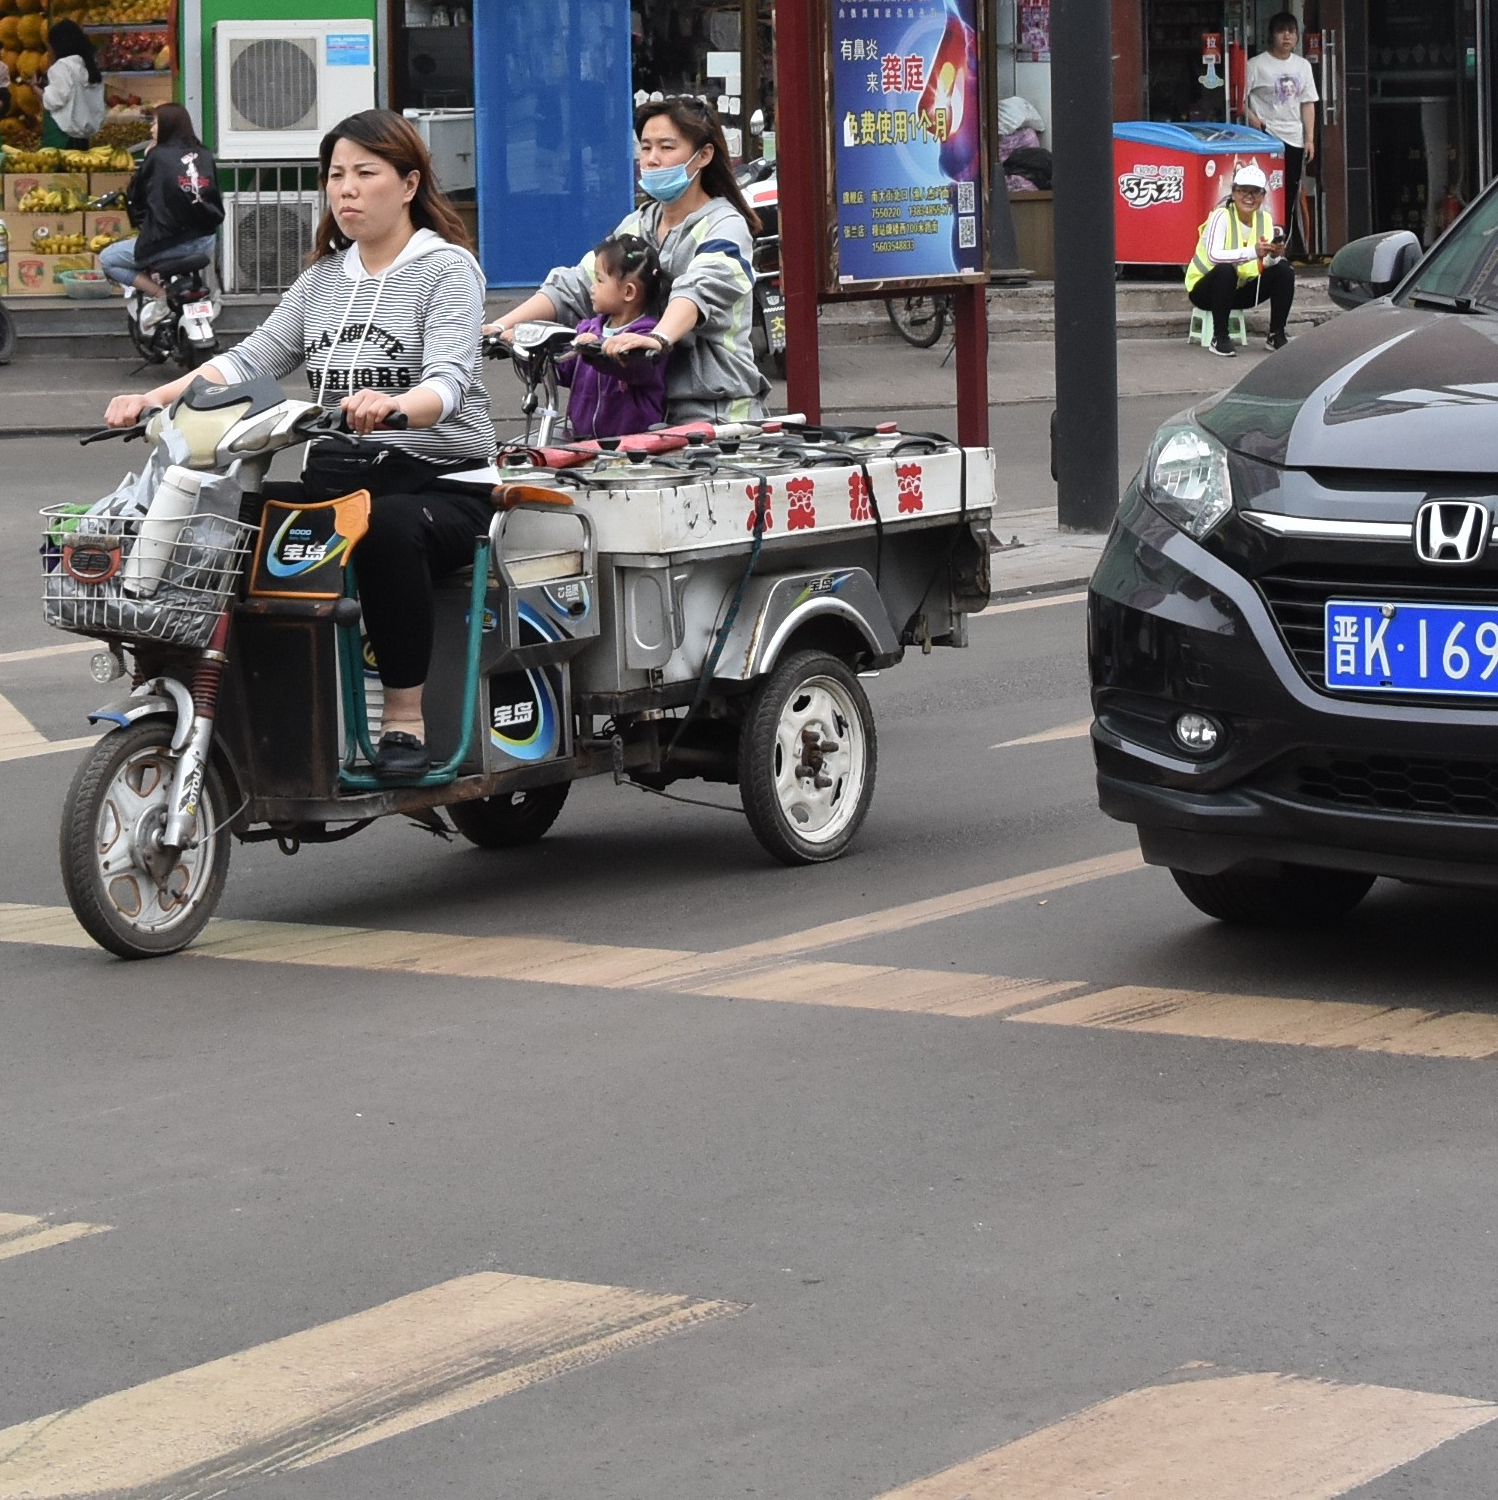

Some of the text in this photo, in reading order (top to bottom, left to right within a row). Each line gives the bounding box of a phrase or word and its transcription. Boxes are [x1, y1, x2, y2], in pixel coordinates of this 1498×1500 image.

[840, 38, 879, 61] 有鼻炎
[867, 53, 925, 94] 来 龚庭
[282, 543, 328, 561] 宝岛
[808, 577, 835, 594] 宝岛
[493, 700, 534, 729] 宝岛
